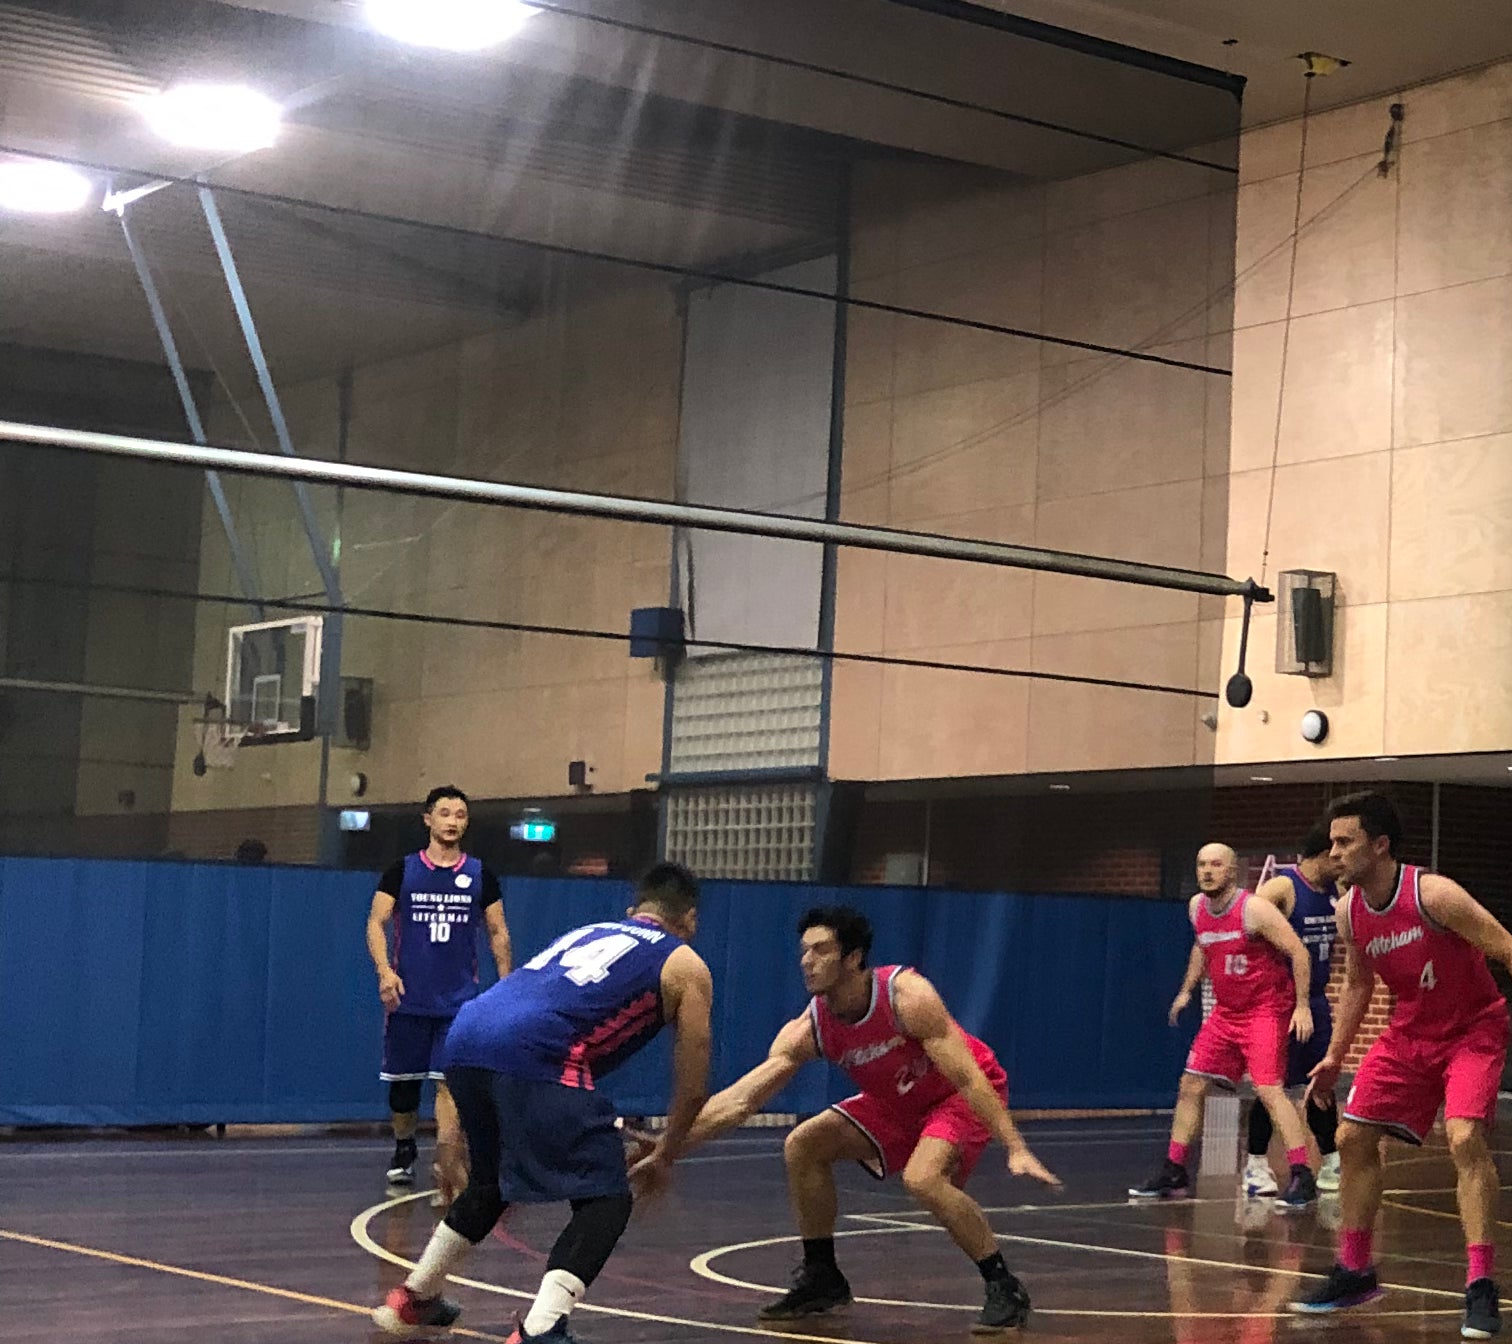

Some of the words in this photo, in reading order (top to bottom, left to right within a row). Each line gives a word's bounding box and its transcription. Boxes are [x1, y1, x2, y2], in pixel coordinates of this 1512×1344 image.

[429, 922, 451, 943] 10
[522, 927, 640, 987] 14
[1419, 959, 1438, 991] 4
